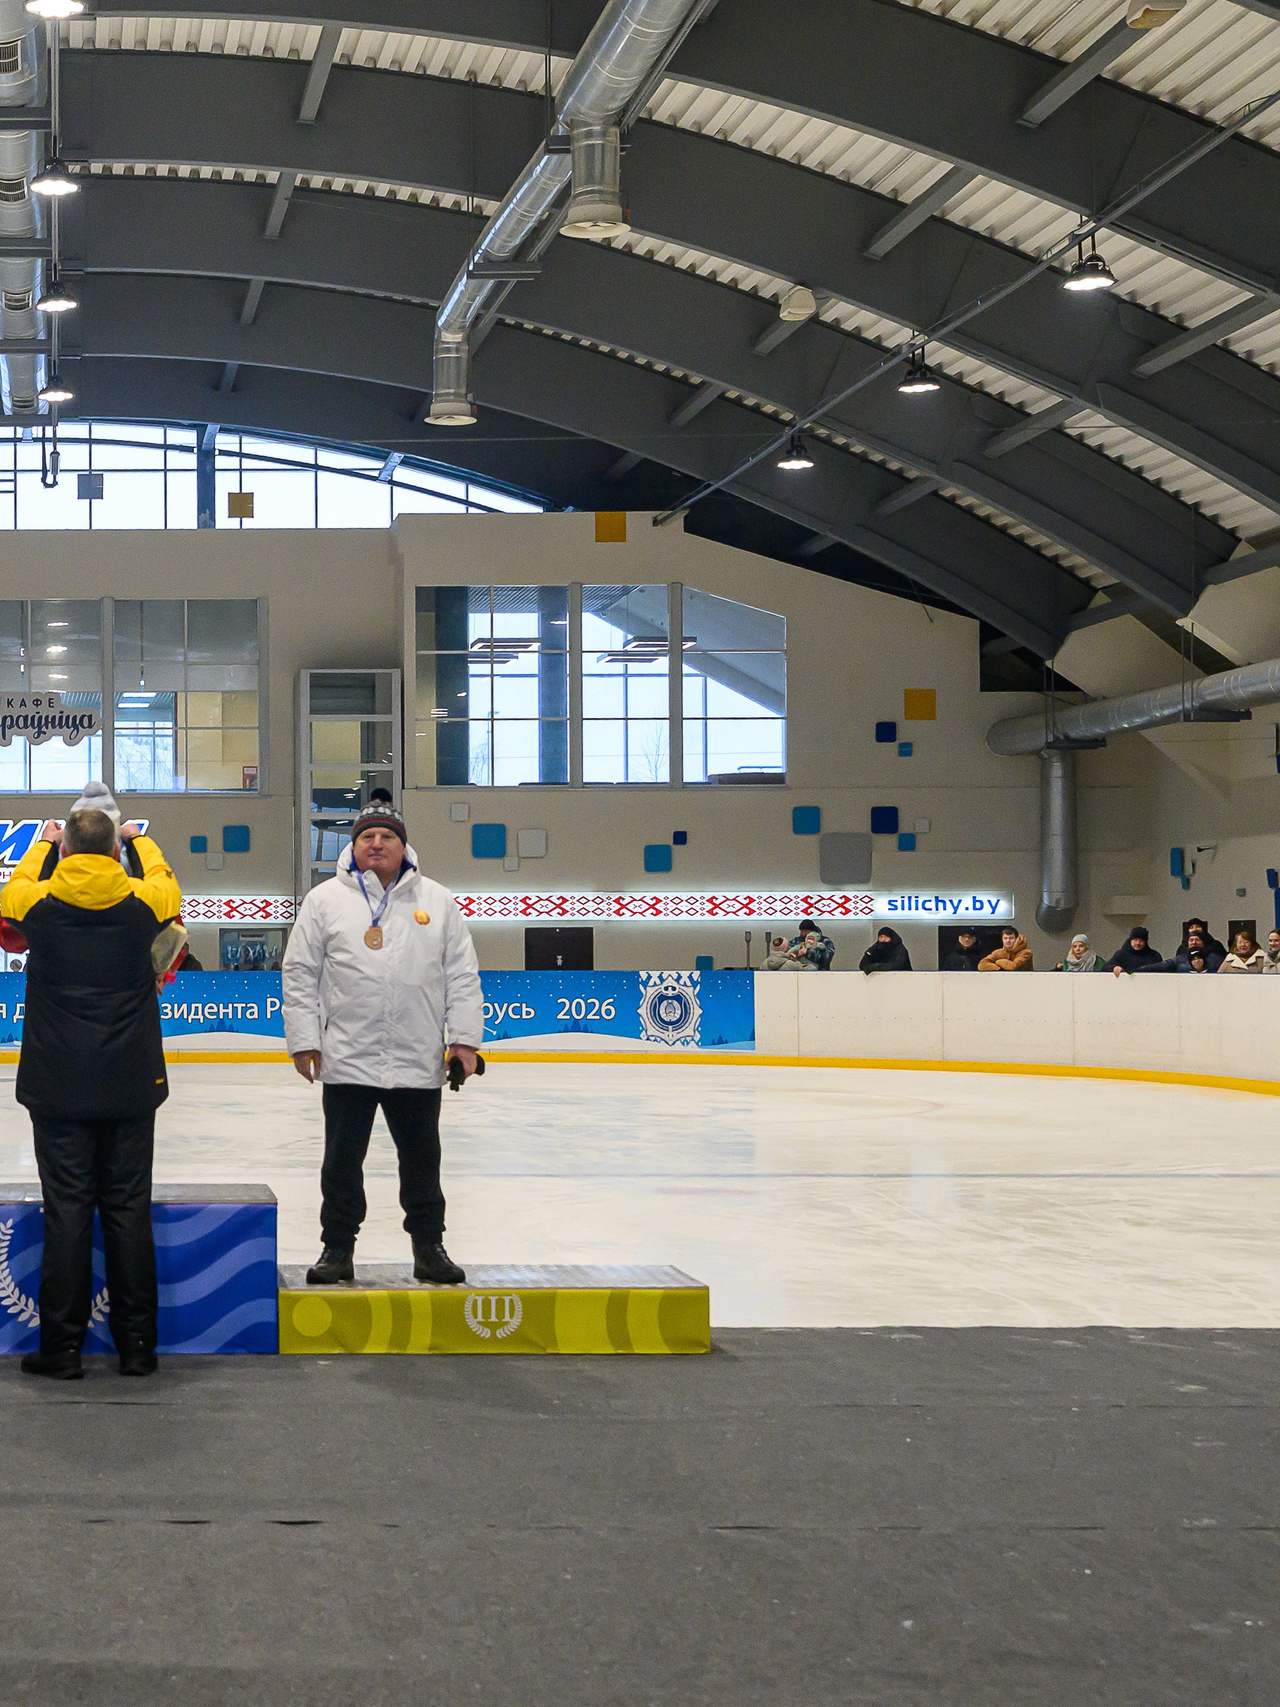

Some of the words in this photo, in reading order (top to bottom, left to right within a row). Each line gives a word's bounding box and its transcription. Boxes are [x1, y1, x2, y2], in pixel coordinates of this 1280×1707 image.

[6, 697, 55, 709] КАФЕ
[887, 895, 1001, 915] silichy.by
[160, 1002, 259, 1024] зидента
[555, 997, 617, 1020] 2026
[474, 1295, 513, 1322] III
